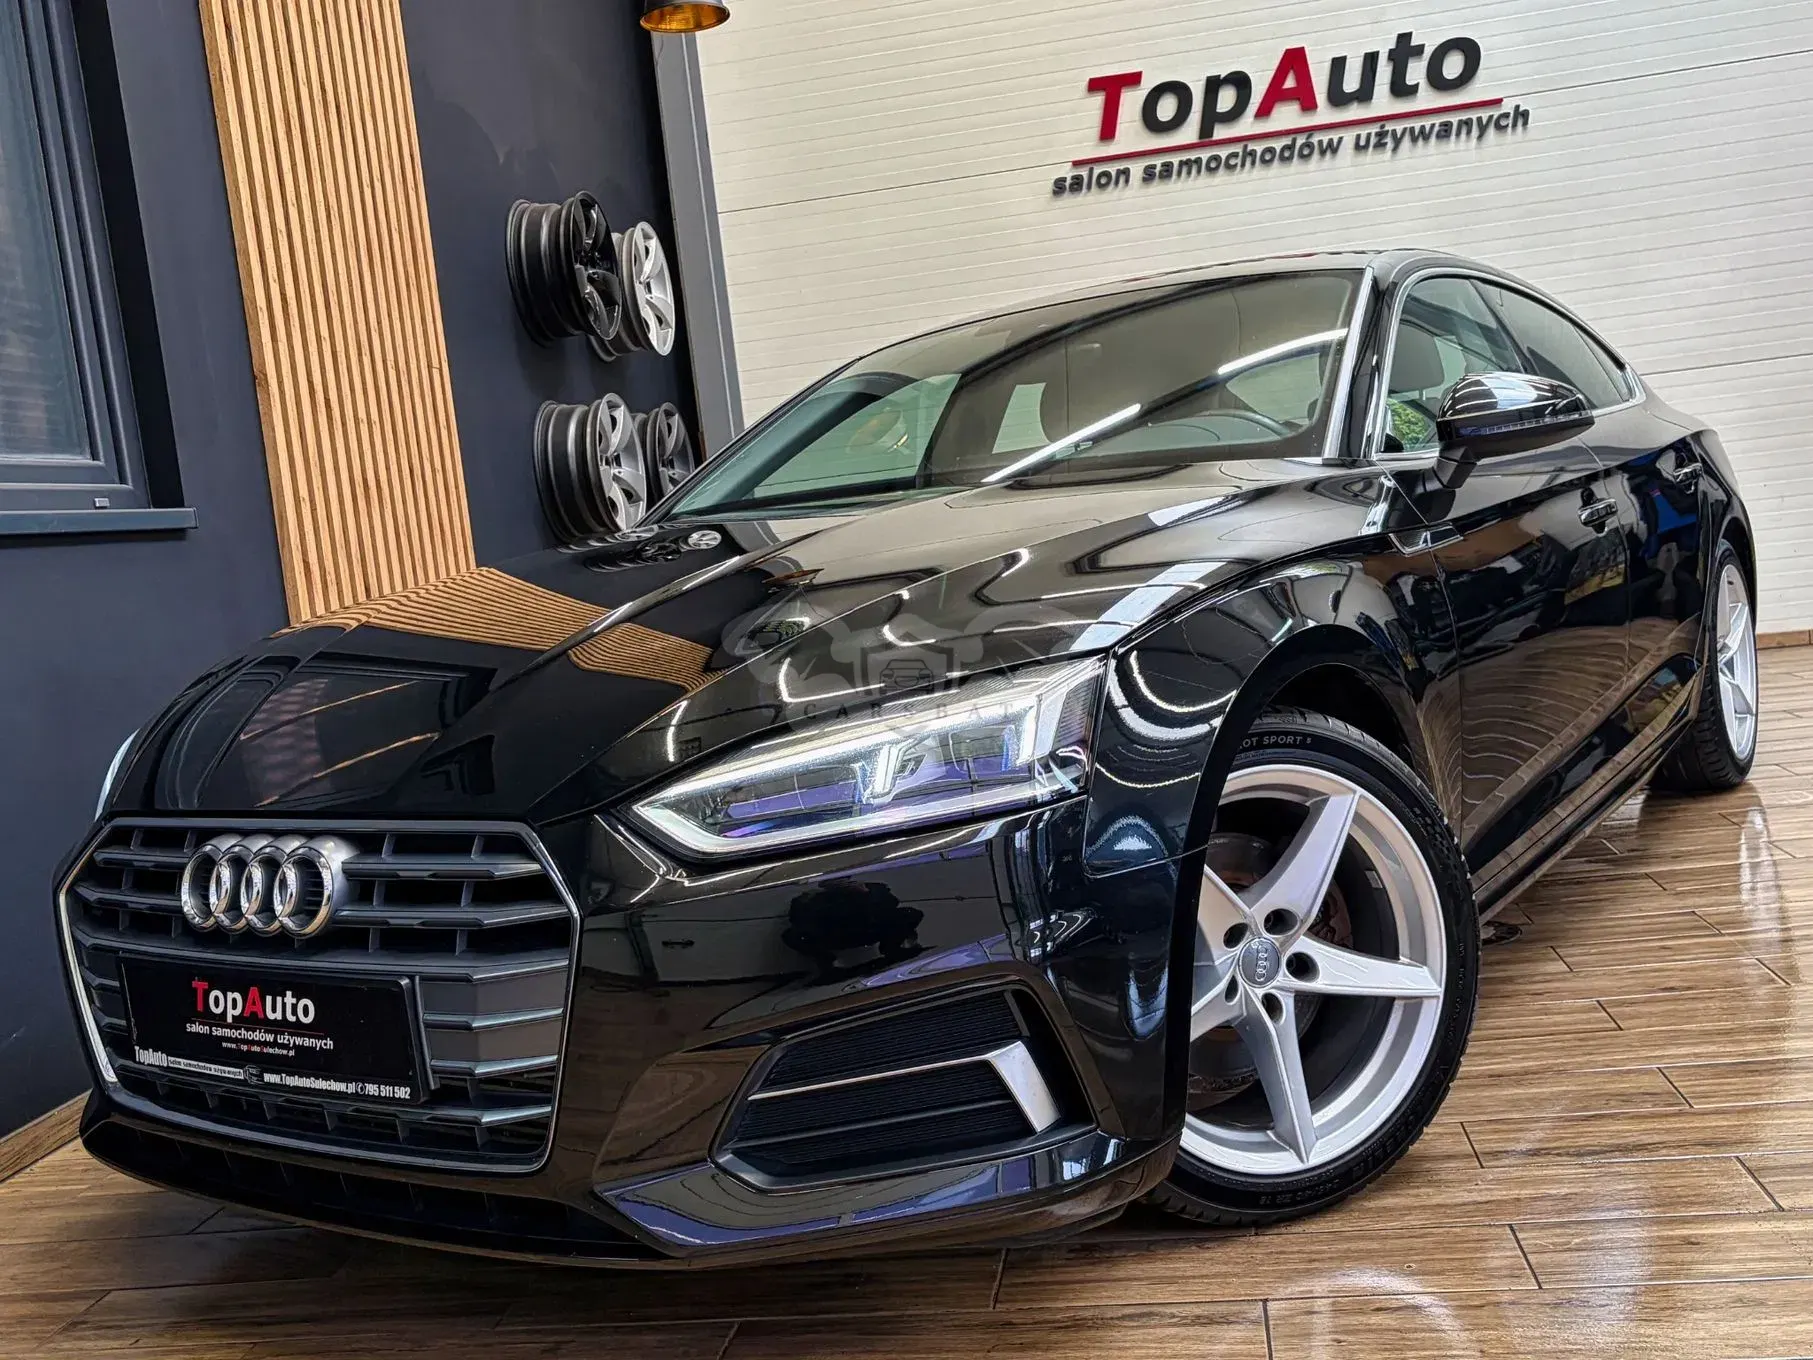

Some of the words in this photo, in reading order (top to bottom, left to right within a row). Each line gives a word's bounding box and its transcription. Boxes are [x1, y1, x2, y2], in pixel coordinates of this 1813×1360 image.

[1087, 31, 1482, 141] TopAuto
[1052, 166, 1130, 196] salon
[1142, 137, 1343, 183] samochodów
[1354, 105, 1530, 153] używanych
[1263, 735, 1302, 745] SPORT
[192, 979, 315, 1023] TopAuto
[186, 1022, 210, 1035] salon
[211, 1027, 275, 1043] samochodów
[277, 1032, 334, 1050] używanych
[134, 1045, 168, 1067] TopAuto
[263, 1072, 356, 1093] www.TopAutoSulechow.pl
[364, 1083, 379, 1097] 795
[380, 1085, 393, 1098] 511
[394, 1086, 411, 1099] 502
